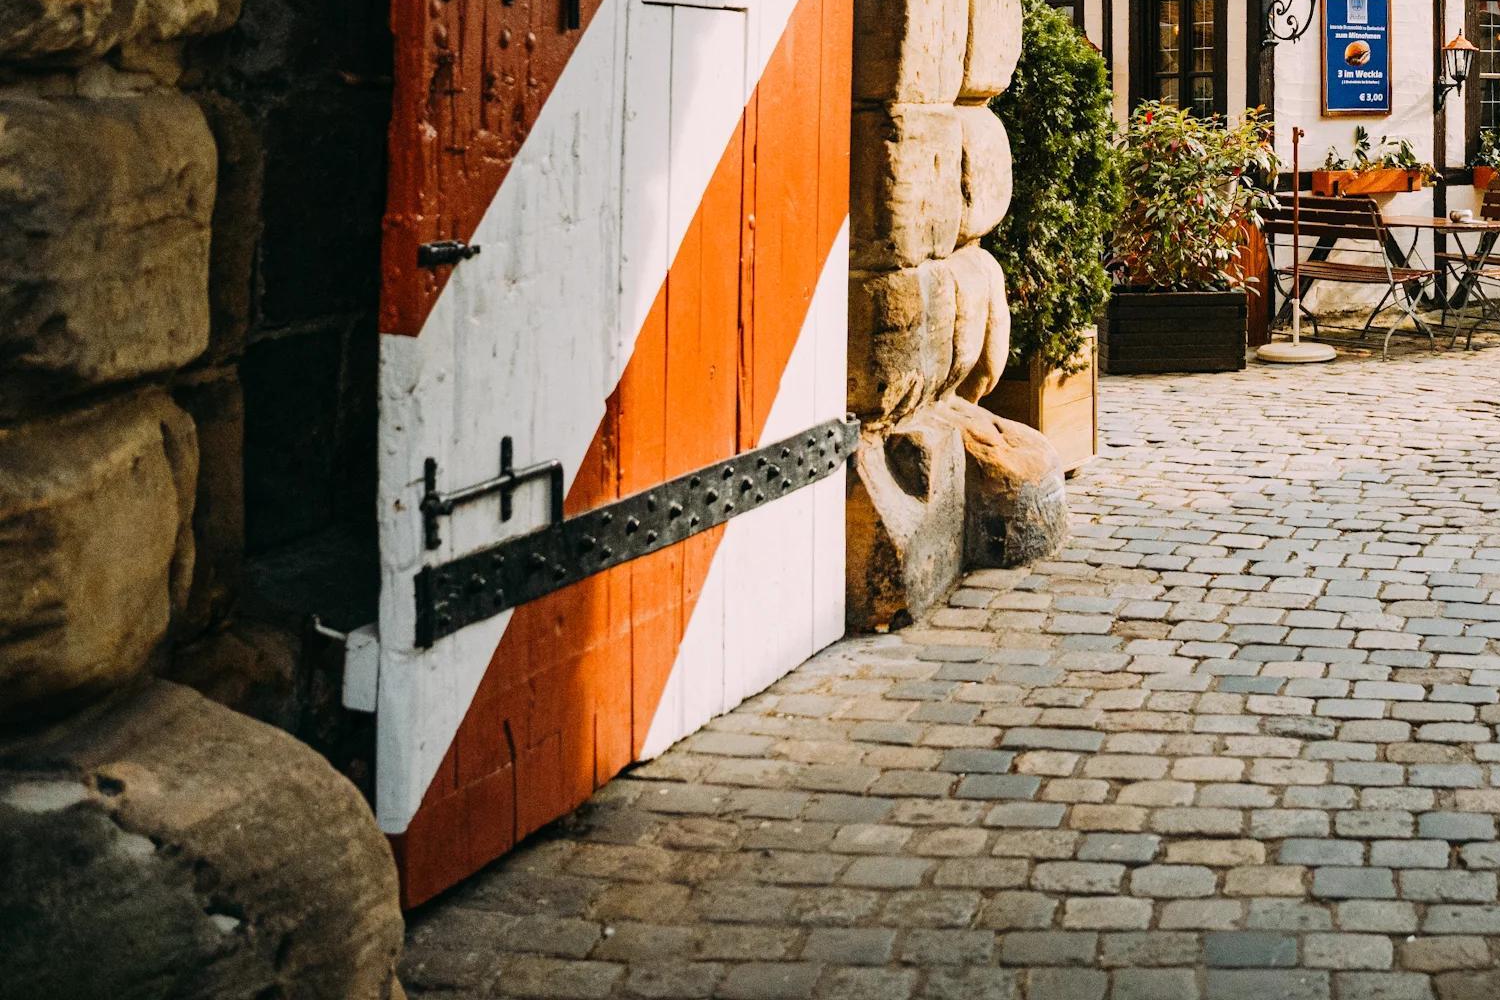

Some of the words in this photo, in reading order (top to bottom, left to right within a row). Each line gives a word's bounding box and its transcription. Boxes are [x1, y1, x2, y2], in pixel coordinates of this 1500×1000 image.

[1337, 70, 1343, 78] 3
[1344, 70, 1354, 78] im
[1359, 93, 1365, 101] €
[1366, 93, 1383, 102] 3,00
